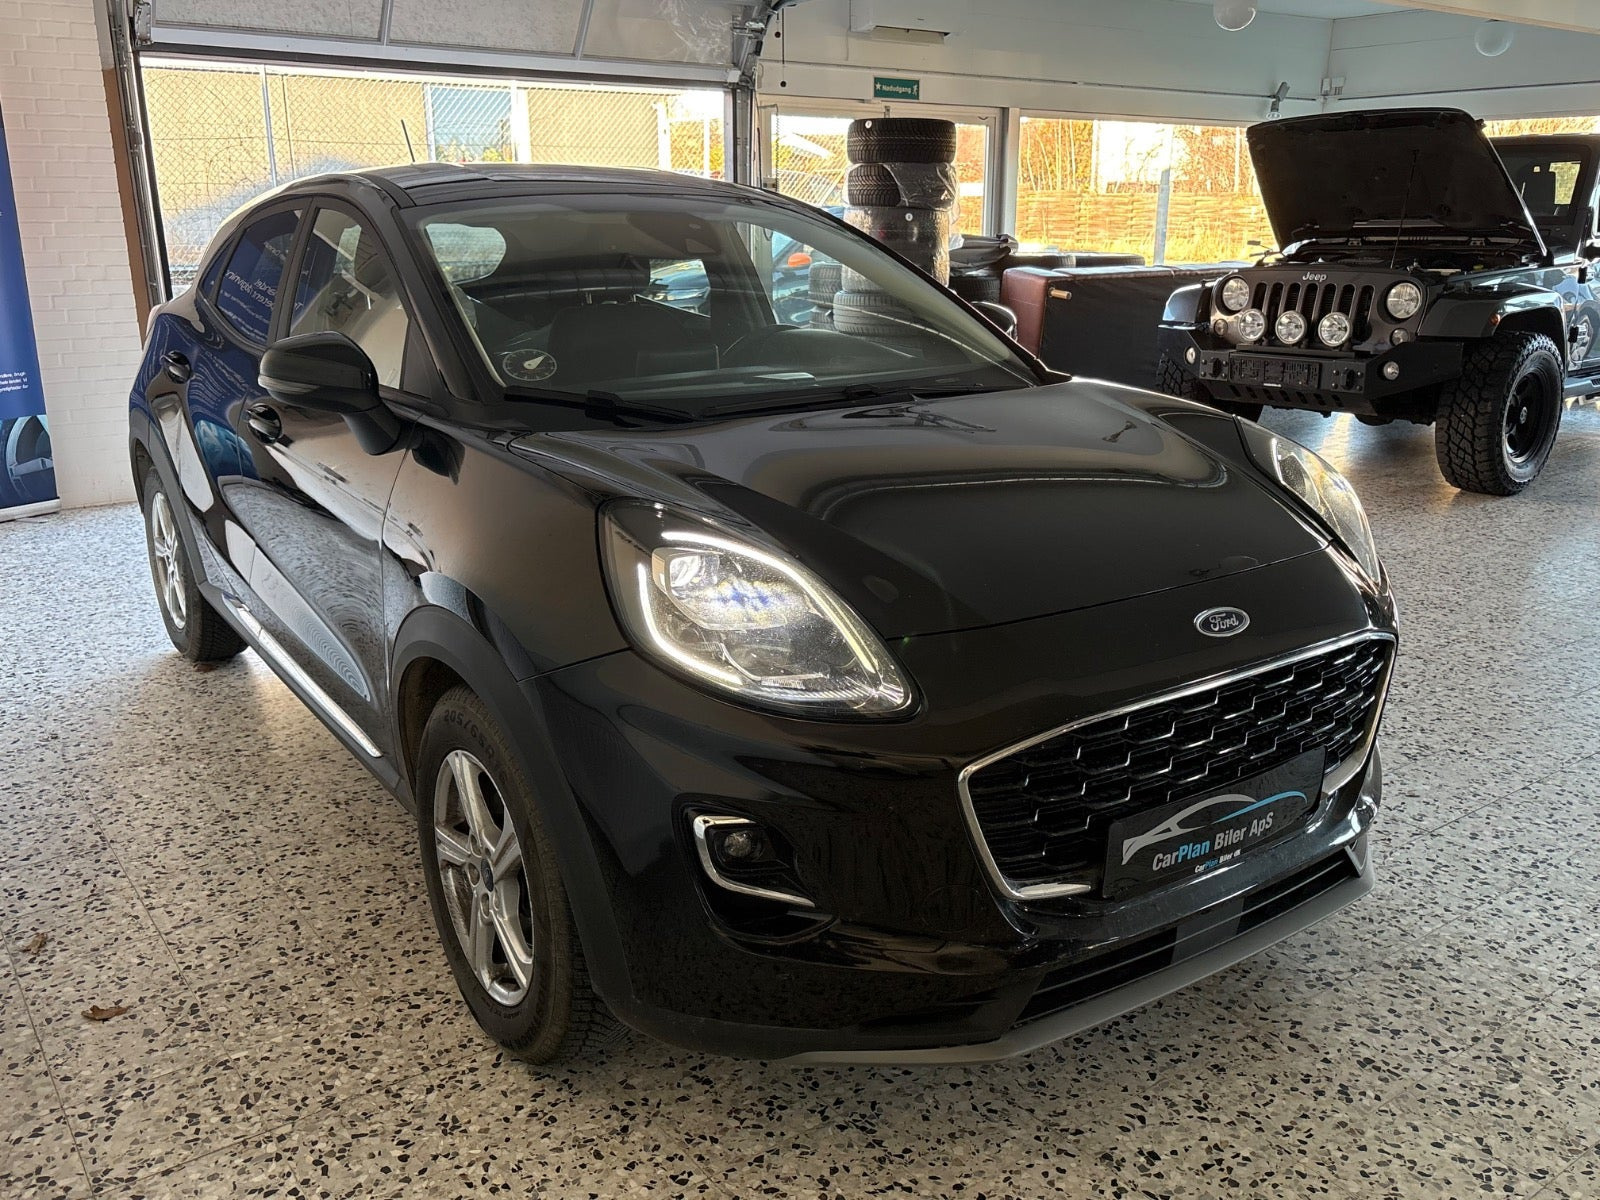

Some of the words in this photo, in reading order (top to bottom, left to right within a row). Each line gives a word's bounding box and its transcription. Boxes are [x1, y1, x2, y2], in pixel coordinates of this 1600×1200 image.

[1302, 271, 1327, 283] Jeep
[1209, 613, 1239, 631] Ford
[1152, 840, 1211, 872] CarPlan
[1214, 827, 1248, 851] Biler
[1249, 811, 1275, 837] ApS
